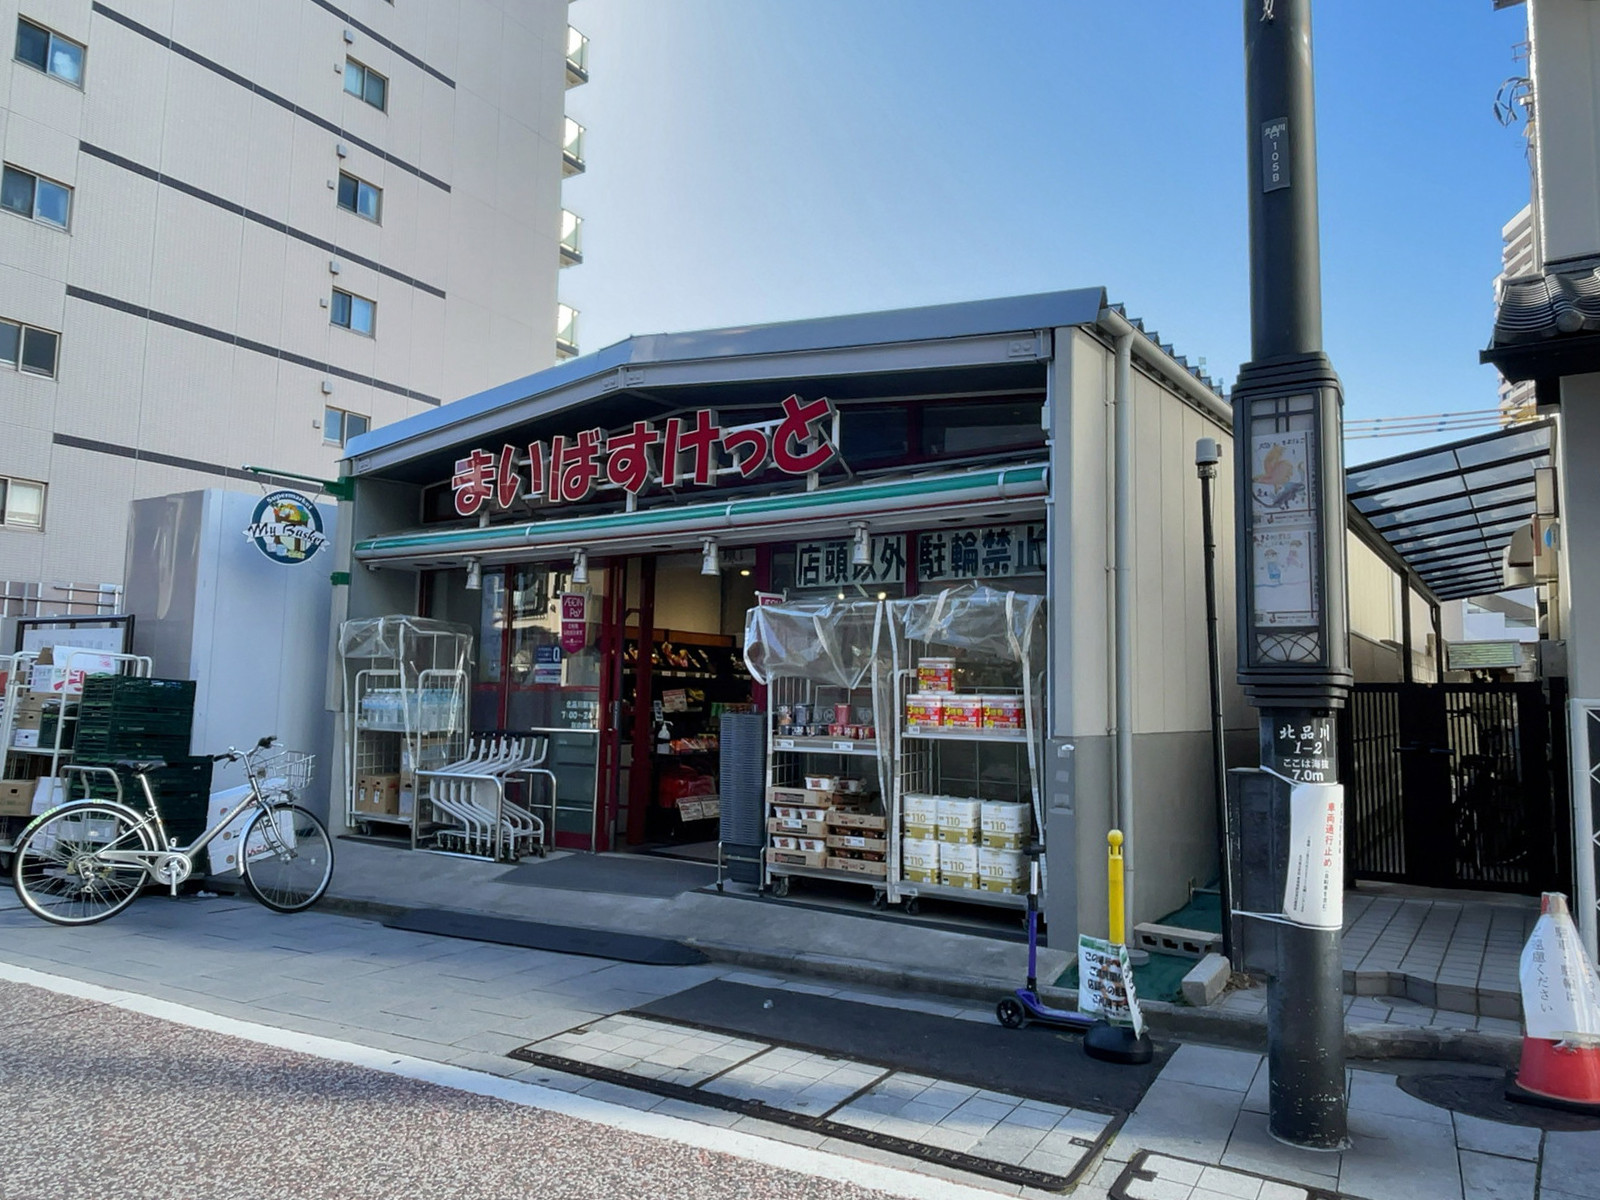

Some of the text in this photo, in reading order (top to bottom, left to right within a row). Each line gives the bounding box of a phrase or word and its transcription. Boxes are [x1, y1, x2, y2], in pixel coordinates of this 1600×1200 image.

[452, 394, 835, 517] まいばすけっと
[266, 492, 313, 510] Supermarket
[247, 521, 325, 547] My Basket
[919, 526, 1043, 581] 駐輪禁止
[1279, 723, 1330, 742] 北品川
[1293, 741, 1323, 755] 1-2
[1283, 758, 1330, 769] ここは海抜
[1291, 769, 1324, 782] 7.0m
[911, 812, 926, 823] 110
[945, 816, 961, 827] 110
[990, 821, 1006, 831] 110
[1322, 802, 1336, 868] 車両通行止め
[909, 856, 924, 866] 110
[949, 861, 965, 872] 110
[988, 866, 1004, 877] 110
